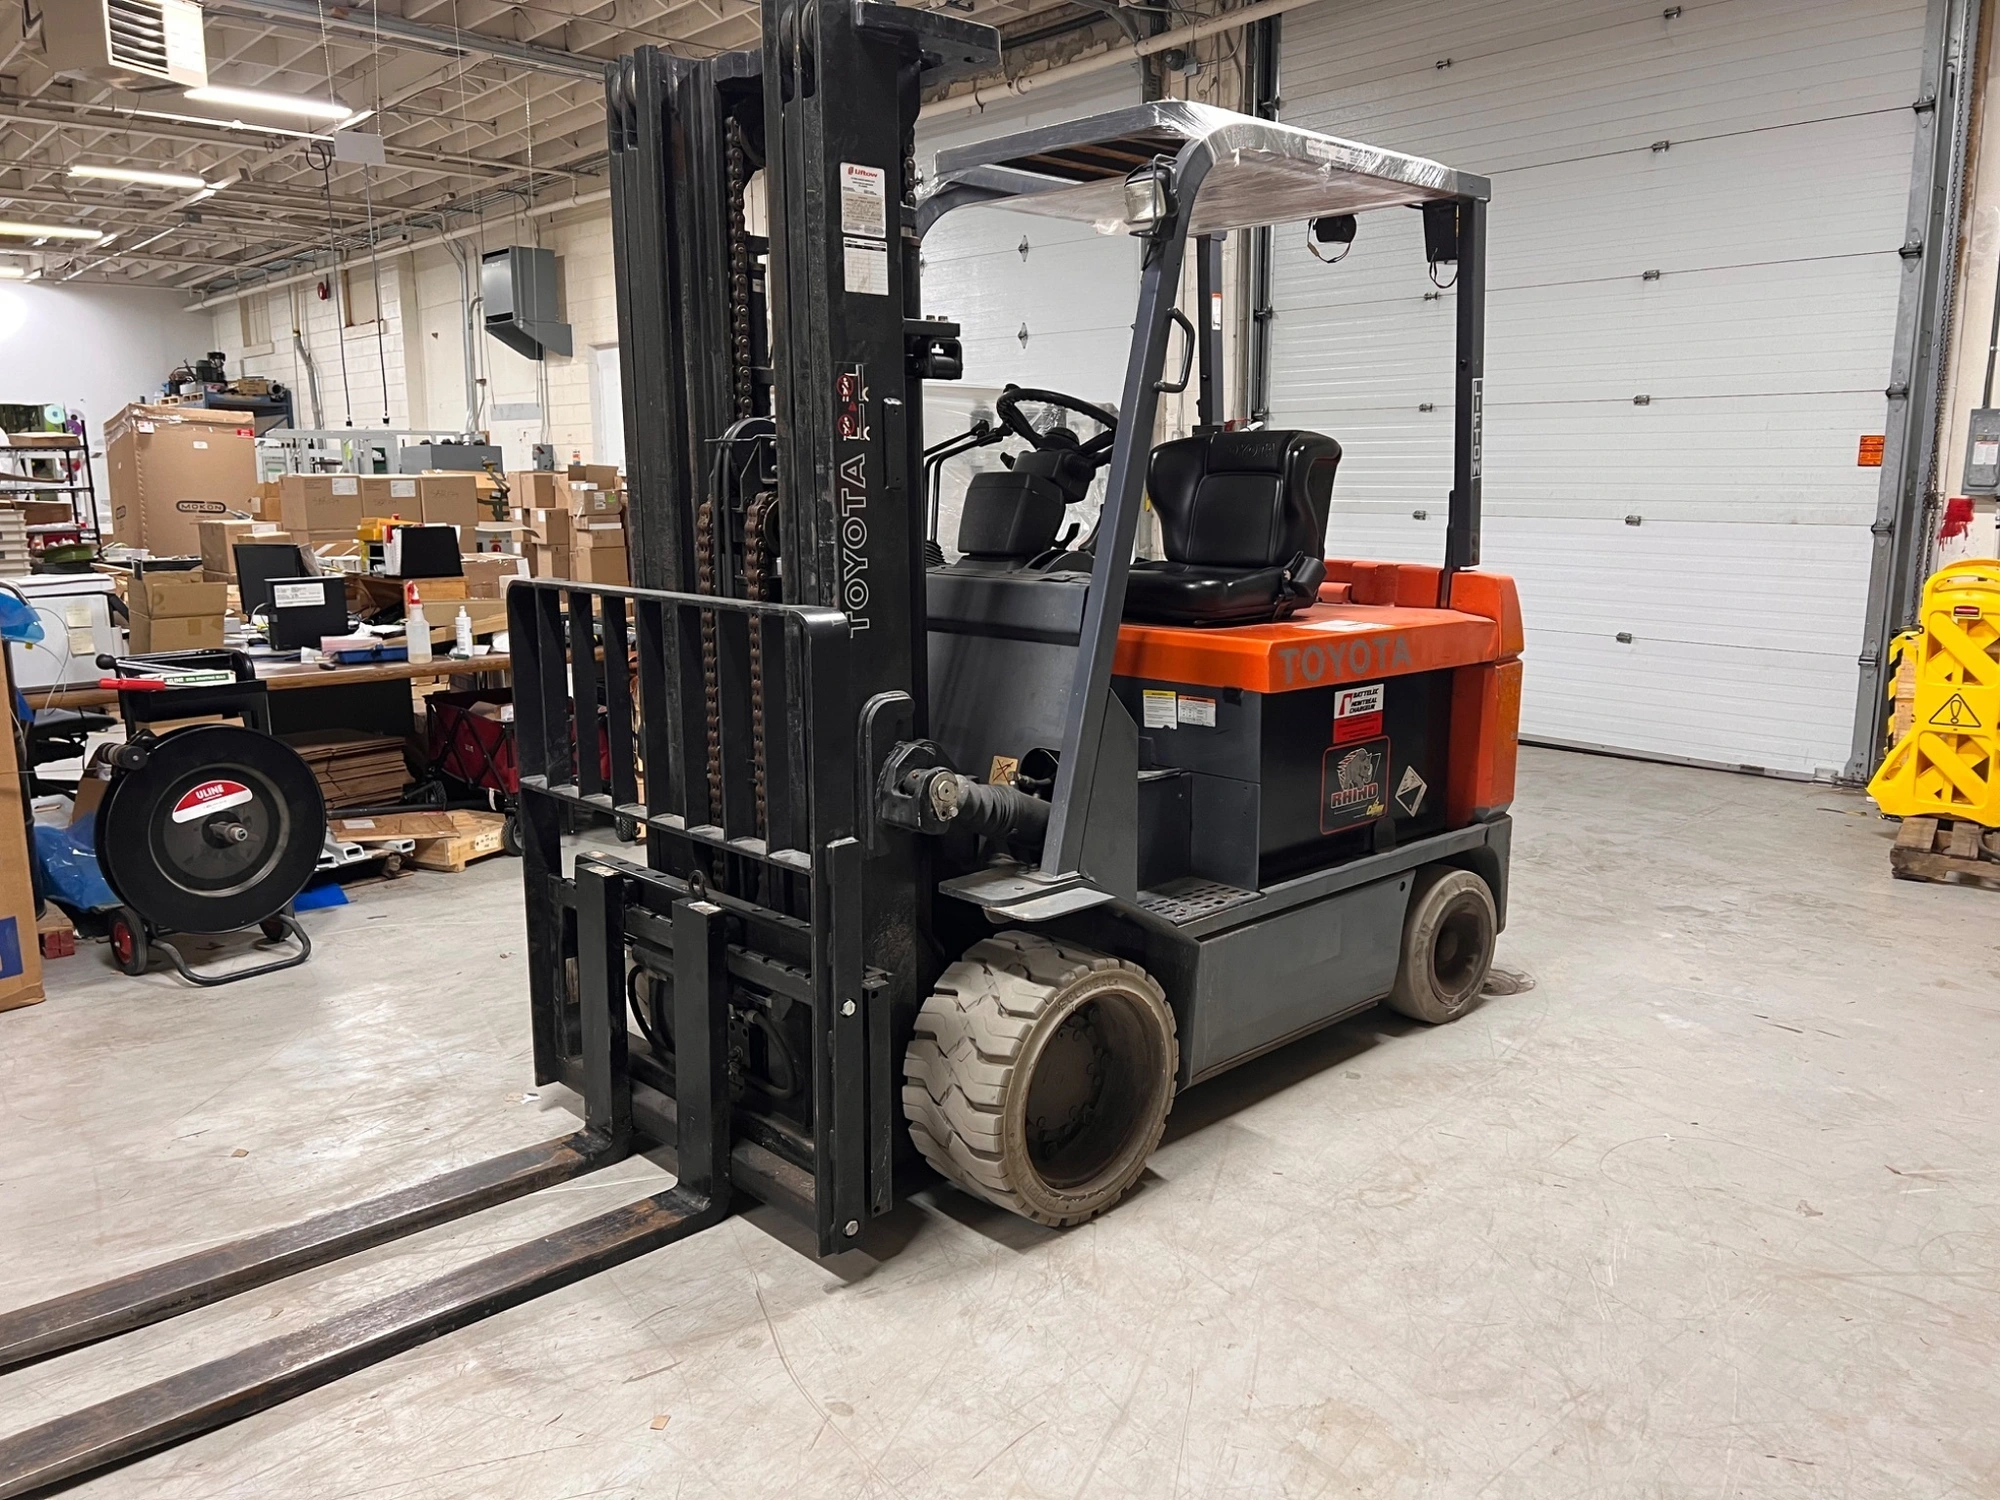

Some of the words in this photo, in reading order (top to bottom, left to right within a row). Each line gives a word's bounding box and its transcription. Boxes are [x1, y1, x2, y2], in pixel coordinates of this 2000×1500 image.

[855, 169, 878, 178] Liftow
[1473, 380, 1482, 477] LIFTOW
[1226, 441, 1276, 457] OYOTA
[840, 453, 869, 637] TOYOTA
[1279, 636, 1411, 683] TOYOTA
[195, 784, 224, 799] ULINE
[1331, 782, 1378, 808] RHINO
